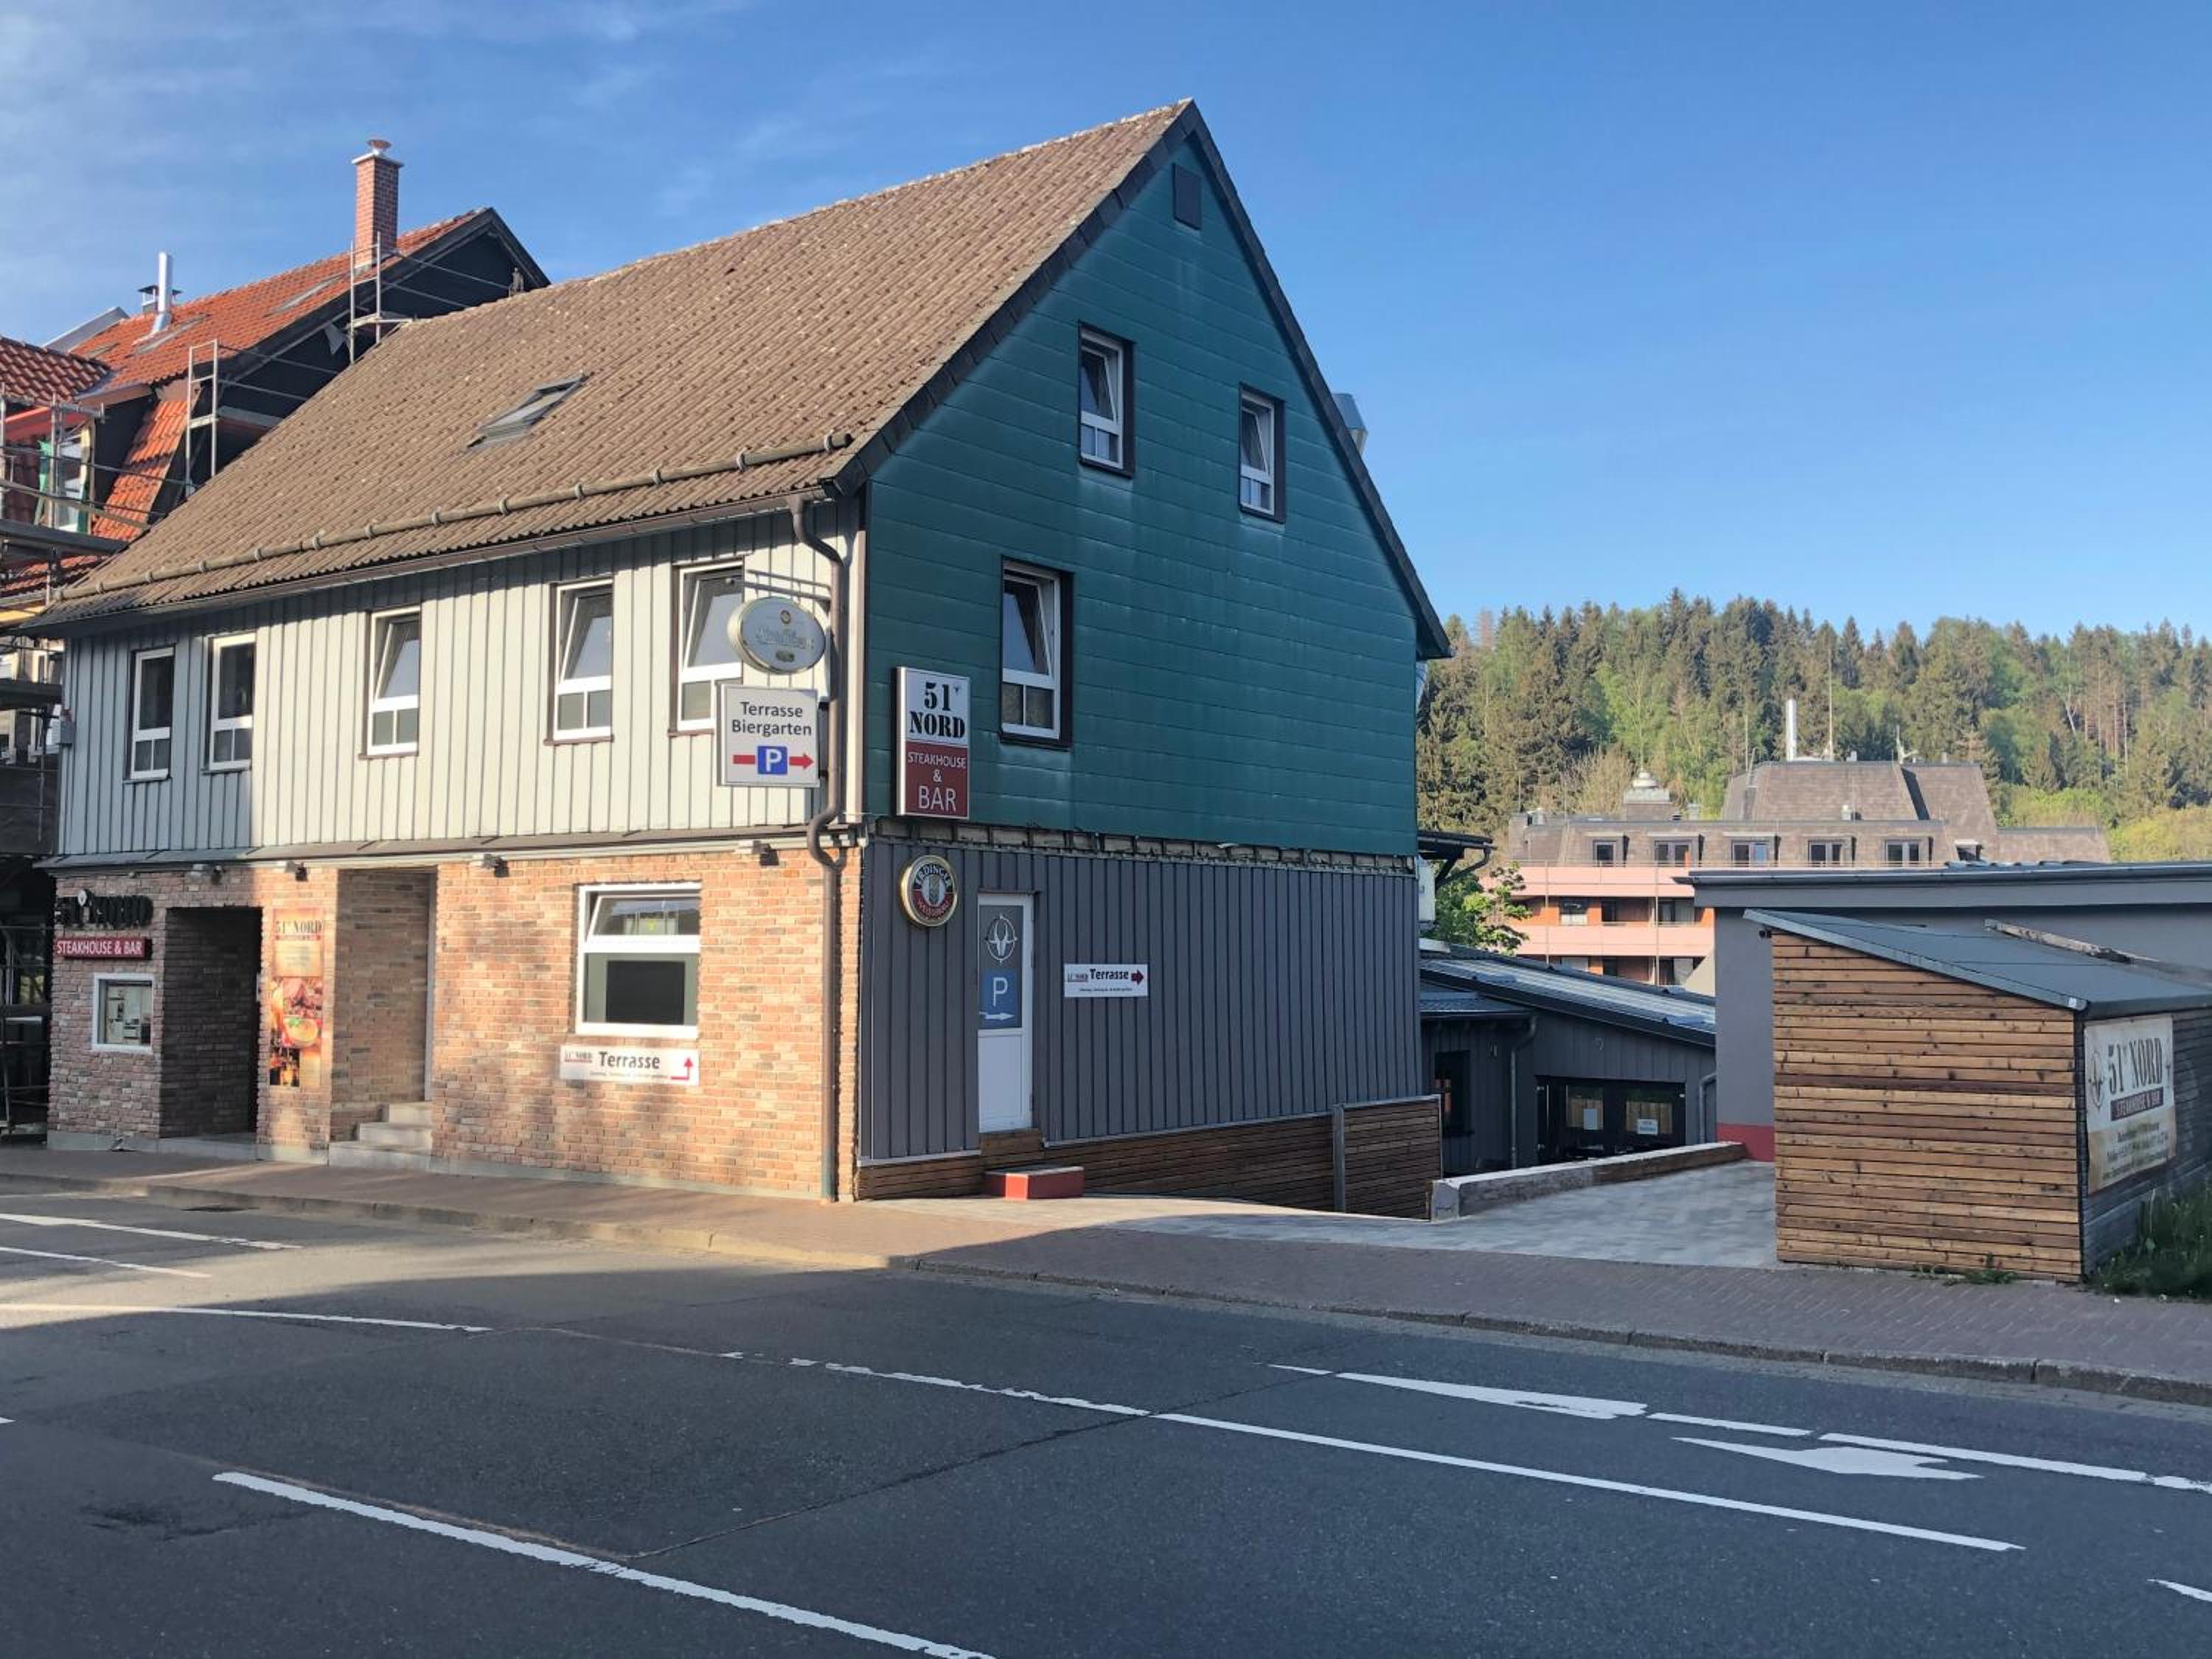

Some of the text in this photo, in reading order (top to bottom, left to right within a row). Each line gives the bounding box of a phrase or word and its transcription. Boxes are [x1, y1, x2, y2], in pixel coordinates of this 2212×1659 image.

[740, 701, 803, 717] Terrasse
[731, 720, 812, 737] Biergarten
[909, 710, 965, 739] NORD
[765, 748, 782, 772] P
[908, 752, 967, 769] STEAKHOUSE
[933, 769, 942, 782] &
[919, 785, 956, 811] BAR
[293, 919, 322, 934] NORD
[57, 939, 142, 955] STEAKHOUSE & BAR
[1090, 968, 1129, 981] Terrasse
[992, 977, 1009, 1006] P
[598, 1051, 661, 1070] Terrasse
[2129, 1037, 2163, 1089] NORD
